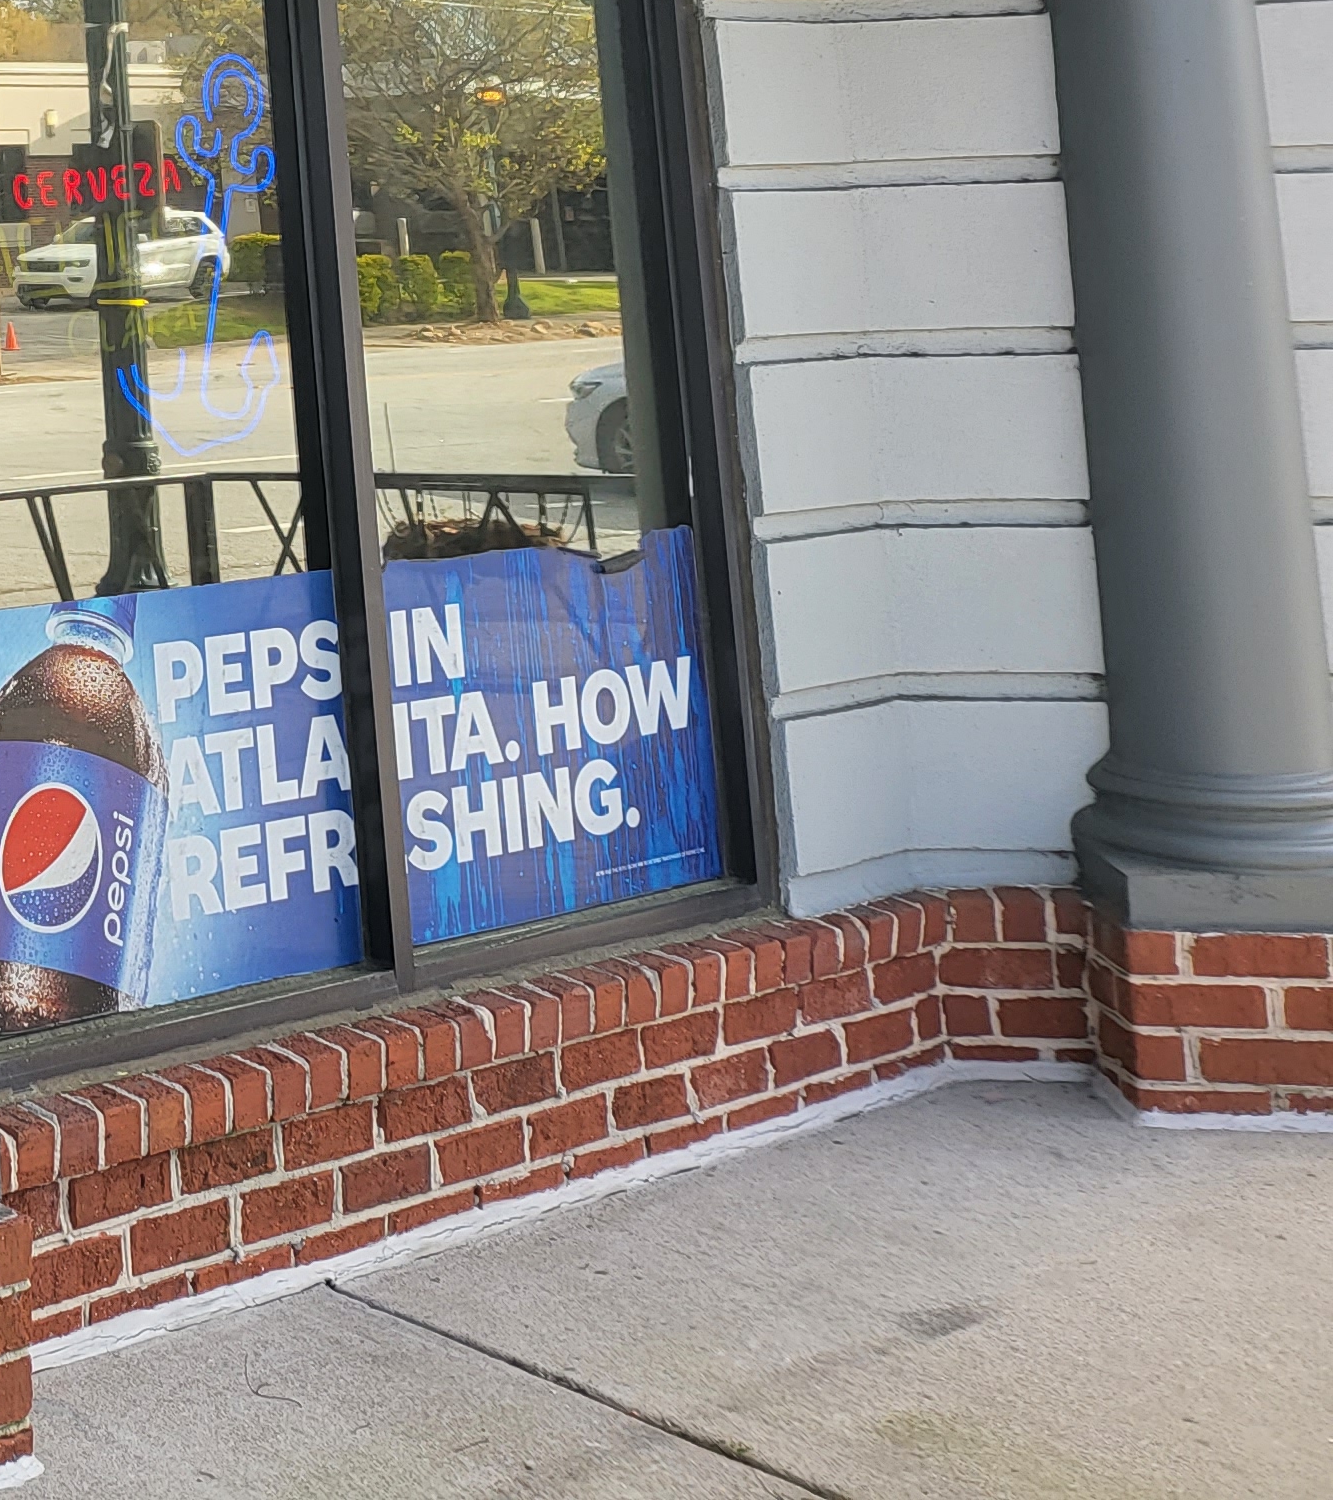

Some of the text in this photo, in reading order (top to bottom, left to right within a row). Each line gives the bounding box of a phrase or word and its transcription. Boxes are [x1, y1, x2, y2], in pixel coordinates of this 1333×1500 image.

[12, 159, 182, 211] CERVEZA
[153, 603, 466, 724] PEPS IN
[533, 655, 691, 756] HOW
[103, 810, 135, 947] pepsi
